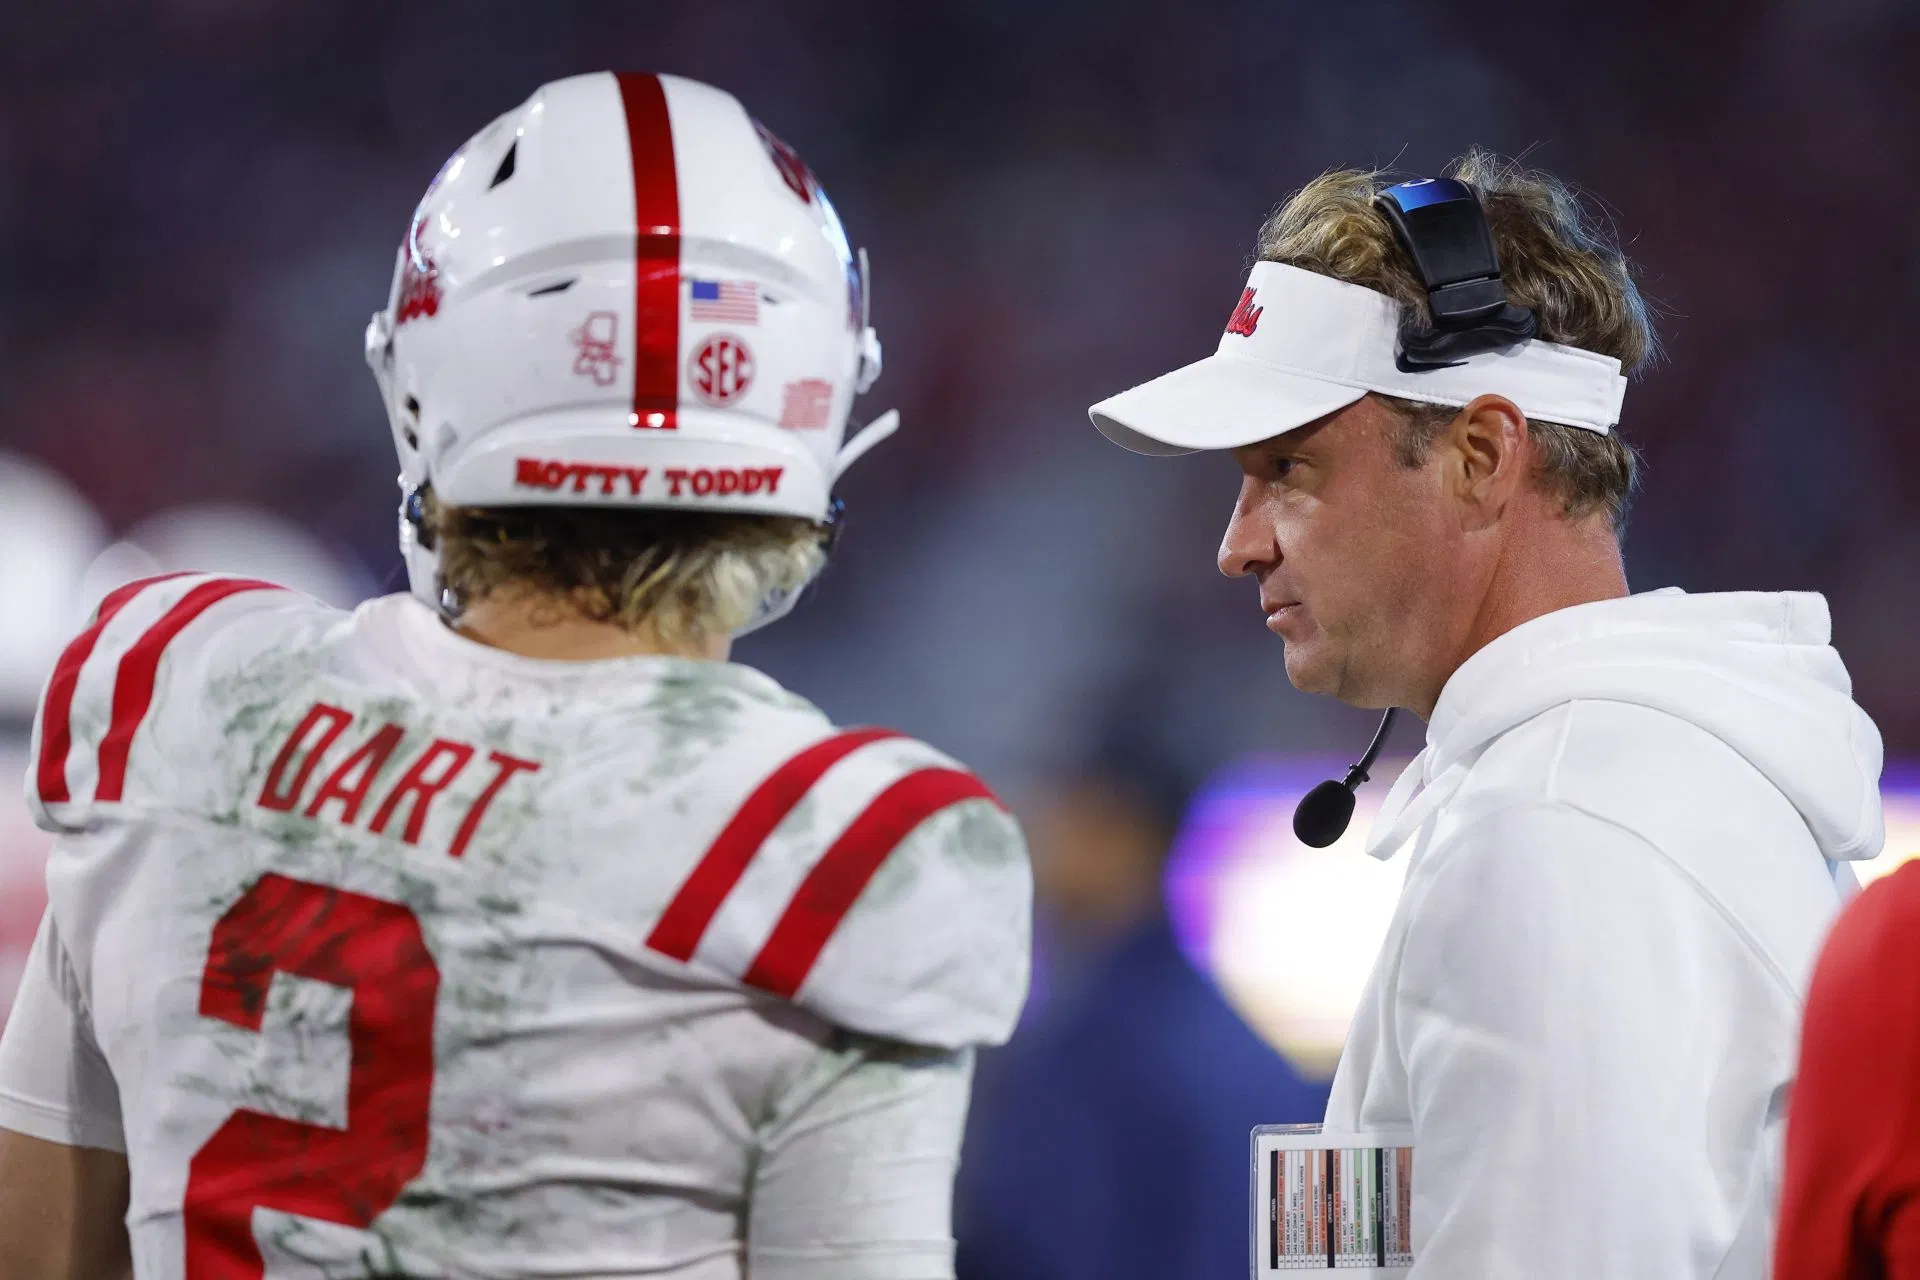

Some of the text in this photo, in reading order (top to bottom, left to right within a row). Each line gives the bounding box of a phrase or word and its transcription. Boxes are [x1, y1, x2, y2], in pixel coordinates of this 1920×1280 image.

[690, 335, 755, 404] SEC
[663, 465, 785, 497] TODDY
[256, 702, 542, 859] DART
[185, 871, 441, 1280] 2
